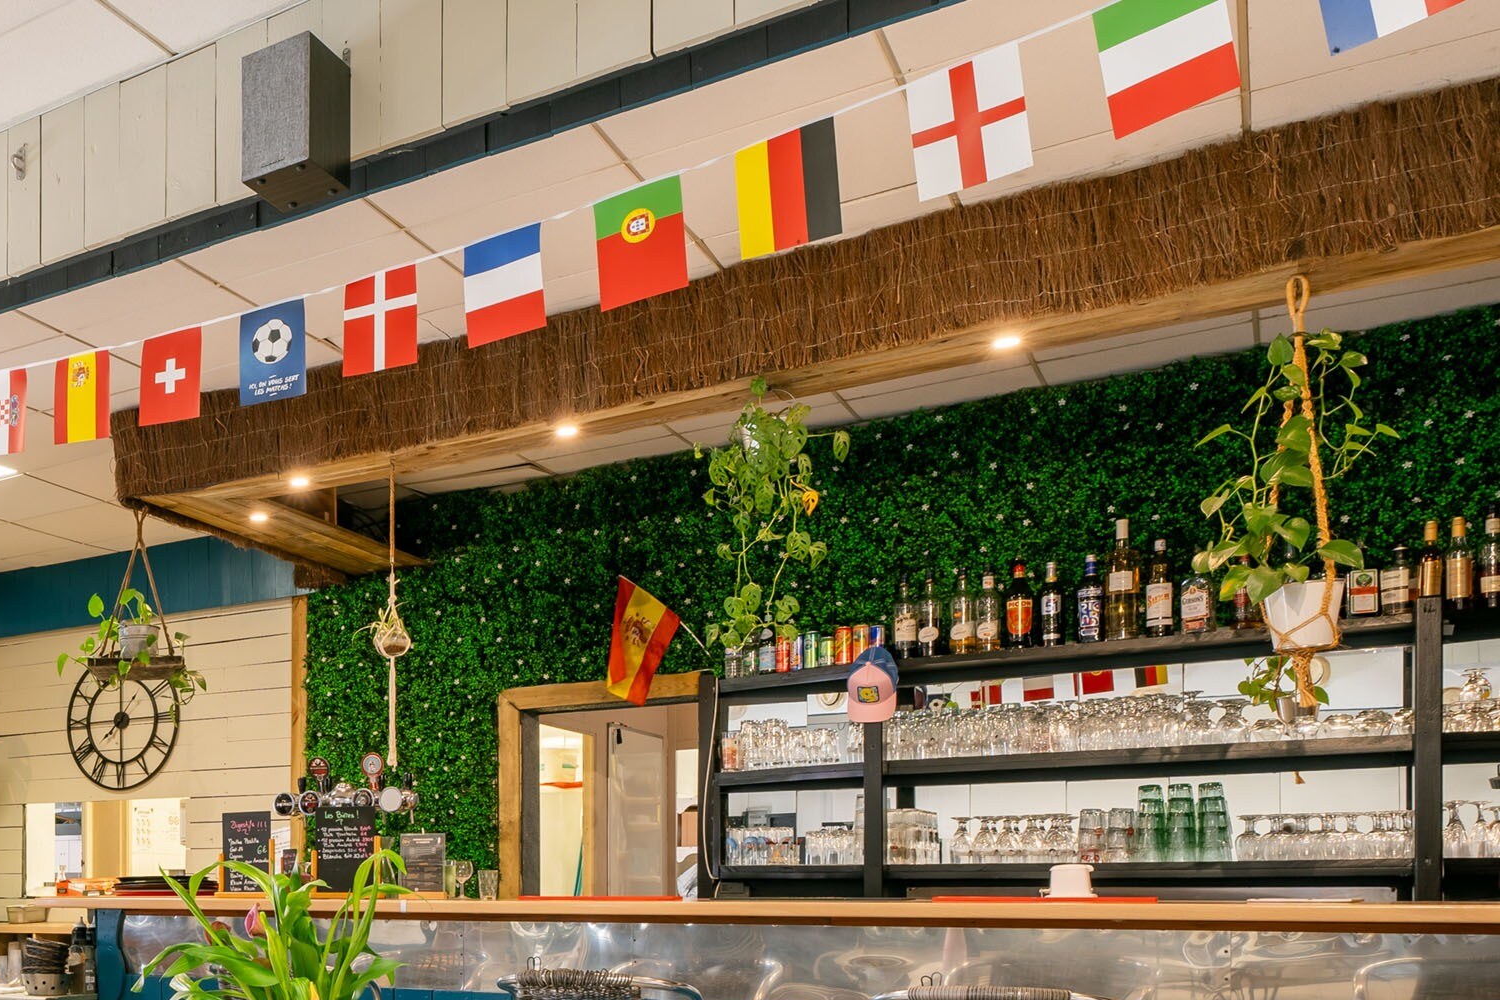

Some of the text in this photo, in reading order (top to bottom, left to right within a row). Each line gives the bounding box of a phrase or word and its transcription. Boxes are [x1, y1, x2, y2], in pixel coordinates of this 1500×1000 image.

[268, 378, 283, 386] VOUS
[285, 374, 300, 383] SERT
[254, 388, 264, 396] LES
[266, 384, 288, 394] MATCHS
